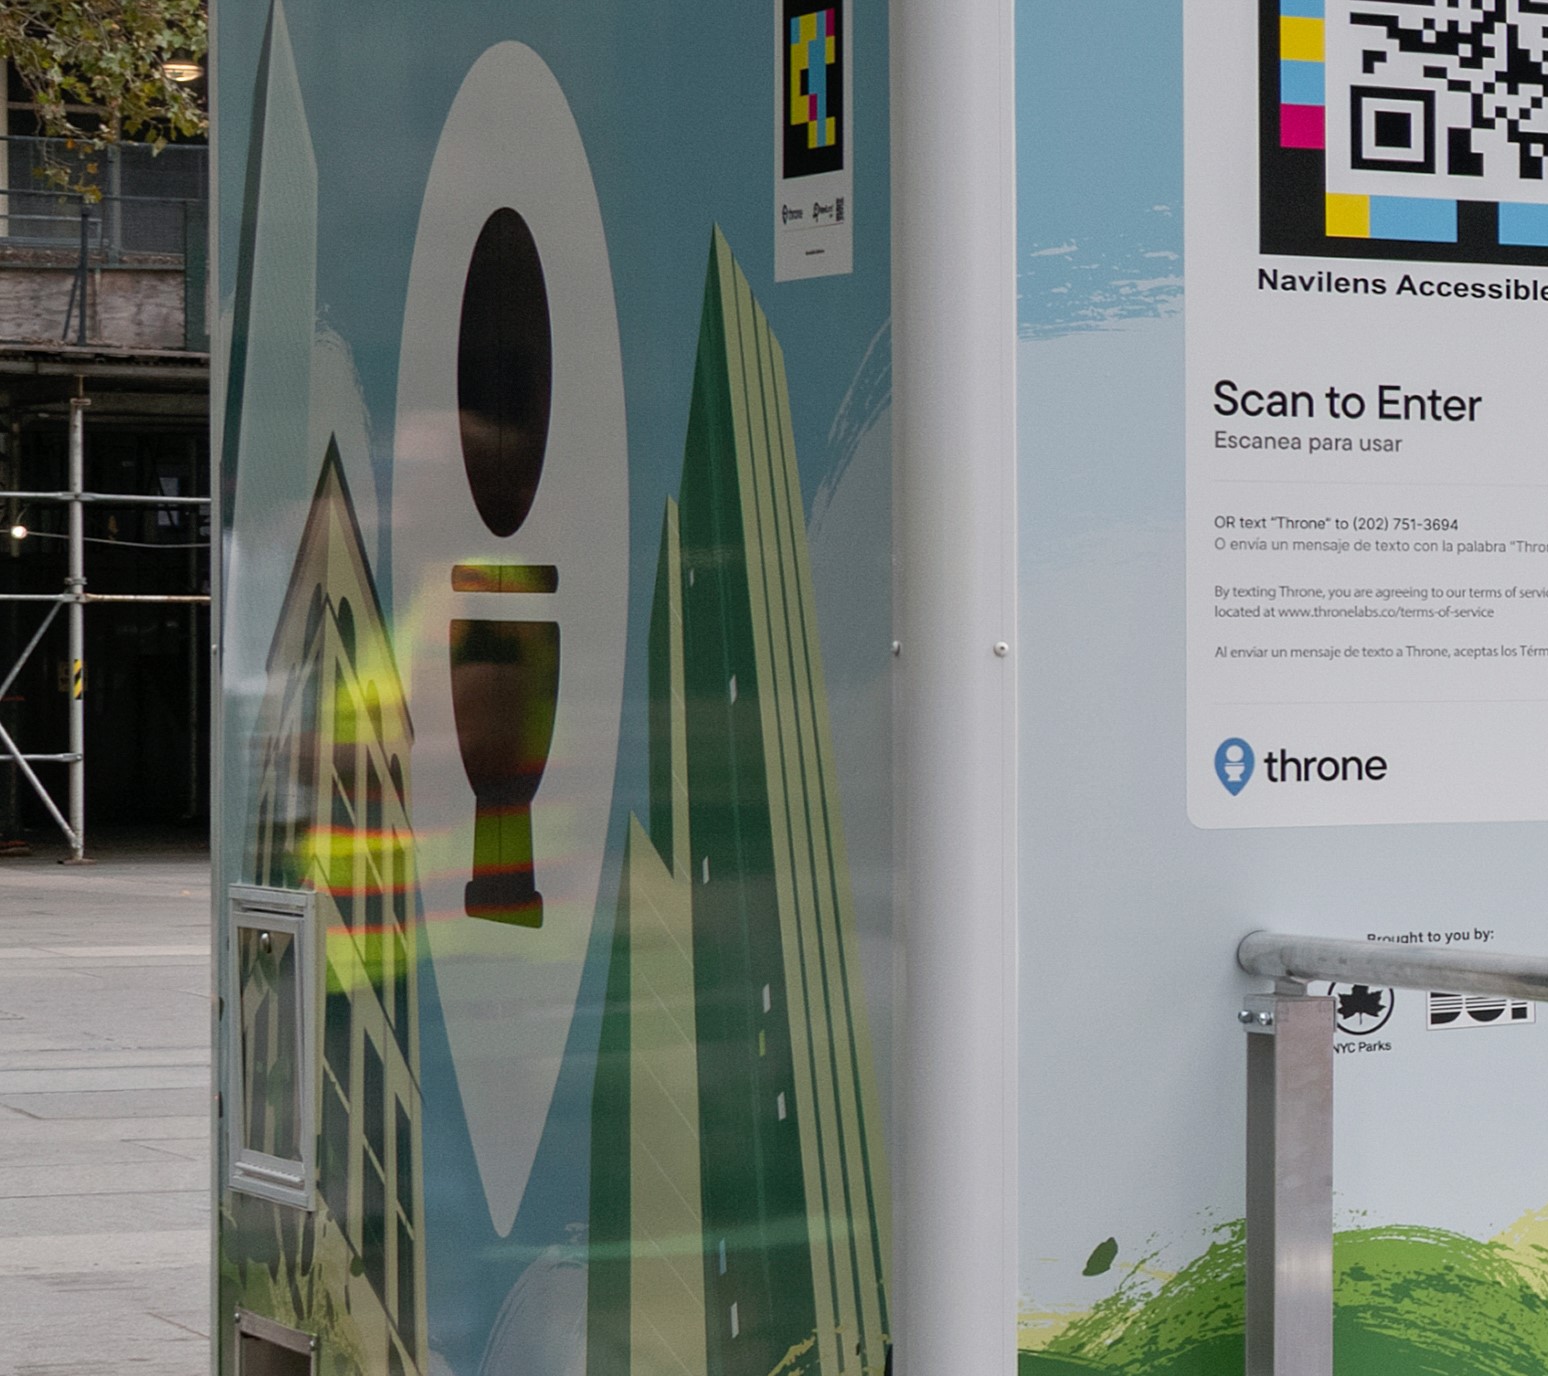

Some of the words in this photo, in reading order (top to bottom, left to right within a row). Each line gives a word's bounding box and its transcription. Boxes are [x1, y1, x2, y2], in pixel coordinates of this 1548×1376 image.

[1257, 268, 1388, 296] Navilens
[1213, 380, 1315, 419] Scan
[1326, 385, 1366, 420] to
[1378, 385, 1483, 421] Enter
[1214, 430, 1302, 452] Escanea
[1308, 434, 1353, 455] para
[1359, 434, 1402, 453] usar
[1214, 515, 1236, 529] OR
[1240, 515, 1267, 529] text
[1335, 517, 1349, 530] to
[1353, 517, 1389, 532] (202)
[1393, 517, 1459, 532] 751-3694
[1214, 537, 1226, 550] O
[1230, 536, 1267, 551] envía
[1271, 540, 1288, 551] un
[1292, 538, 1350, 555] mensaje
[1353, 539, 1371, 552] de
[1375, 540, 1410, 553] texto
[1413, 542, 1438, 553] con
[1442, 540, 1453, 552] la
[1457, 540, 1507, 556] palabra
[1214, 585, 1230, 600] By
[1232, 585, 1277, 601] texting
[1279, 585, 1326, 599] Throne,
[1328, 588, 1351, 601] you
[1353, 588, 1373, 599] are
[1375, 586, 1428, 601] agreeing
[1431, 588, 1444, 599] to
[1446, 589, 1466, 599] our
[1469, 588, 1502, 599] terms
[1505, 586, 1517, 599] of
[1214, 605, 1261, 619] located
[1263, 606, 1275, 618] at
[1214, 645, 1227, 658] Al
[1230, 645, 1268, 658] enviar
[1271, 648, 1288, 658] un
[1290, 645, 1341, 661] mensaje
[1343, 645, 1360, 658] de
[1362, 646, 1393, 658] texto
[1395, 649, 1403, 658] a
[1453, 645, 1499, 660] aceptas
[1501, 644, 1518, 657] los
[1263, 748, 1388, 783] throne
[1427, 932, 1441, 943] to
[1445, 932, 1470, 945] you
[1474, 928, 1495, 943] by:
[1358, 1041, 1392, 1053] Parks
